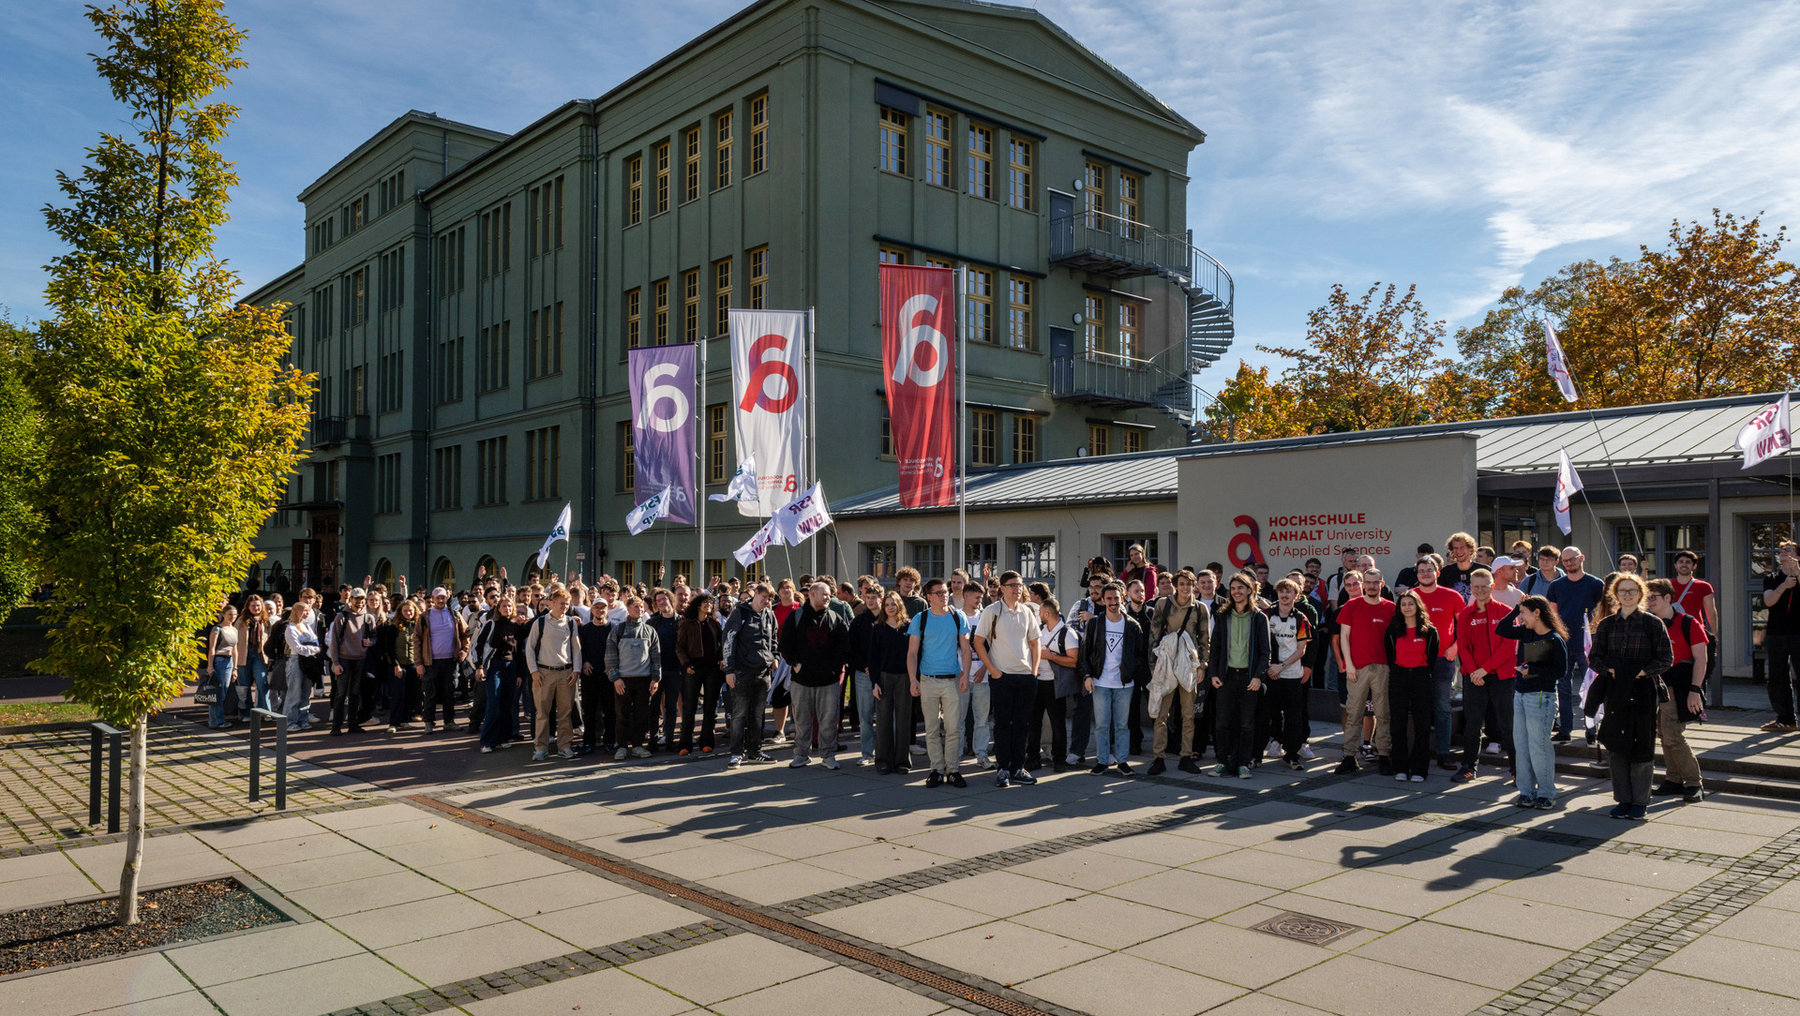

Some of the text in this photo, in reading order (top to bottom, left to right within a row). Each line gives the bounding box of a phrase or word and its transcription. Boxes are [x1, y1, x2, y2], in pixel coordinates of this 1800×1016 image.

[1269, 513, 1366, 527] HOCHSCHULE
[1269, 527, 1392, 542] ANHALT University
[1269, 545, 1282, 557] of
[1283, 544, 1330, 558] Applied
